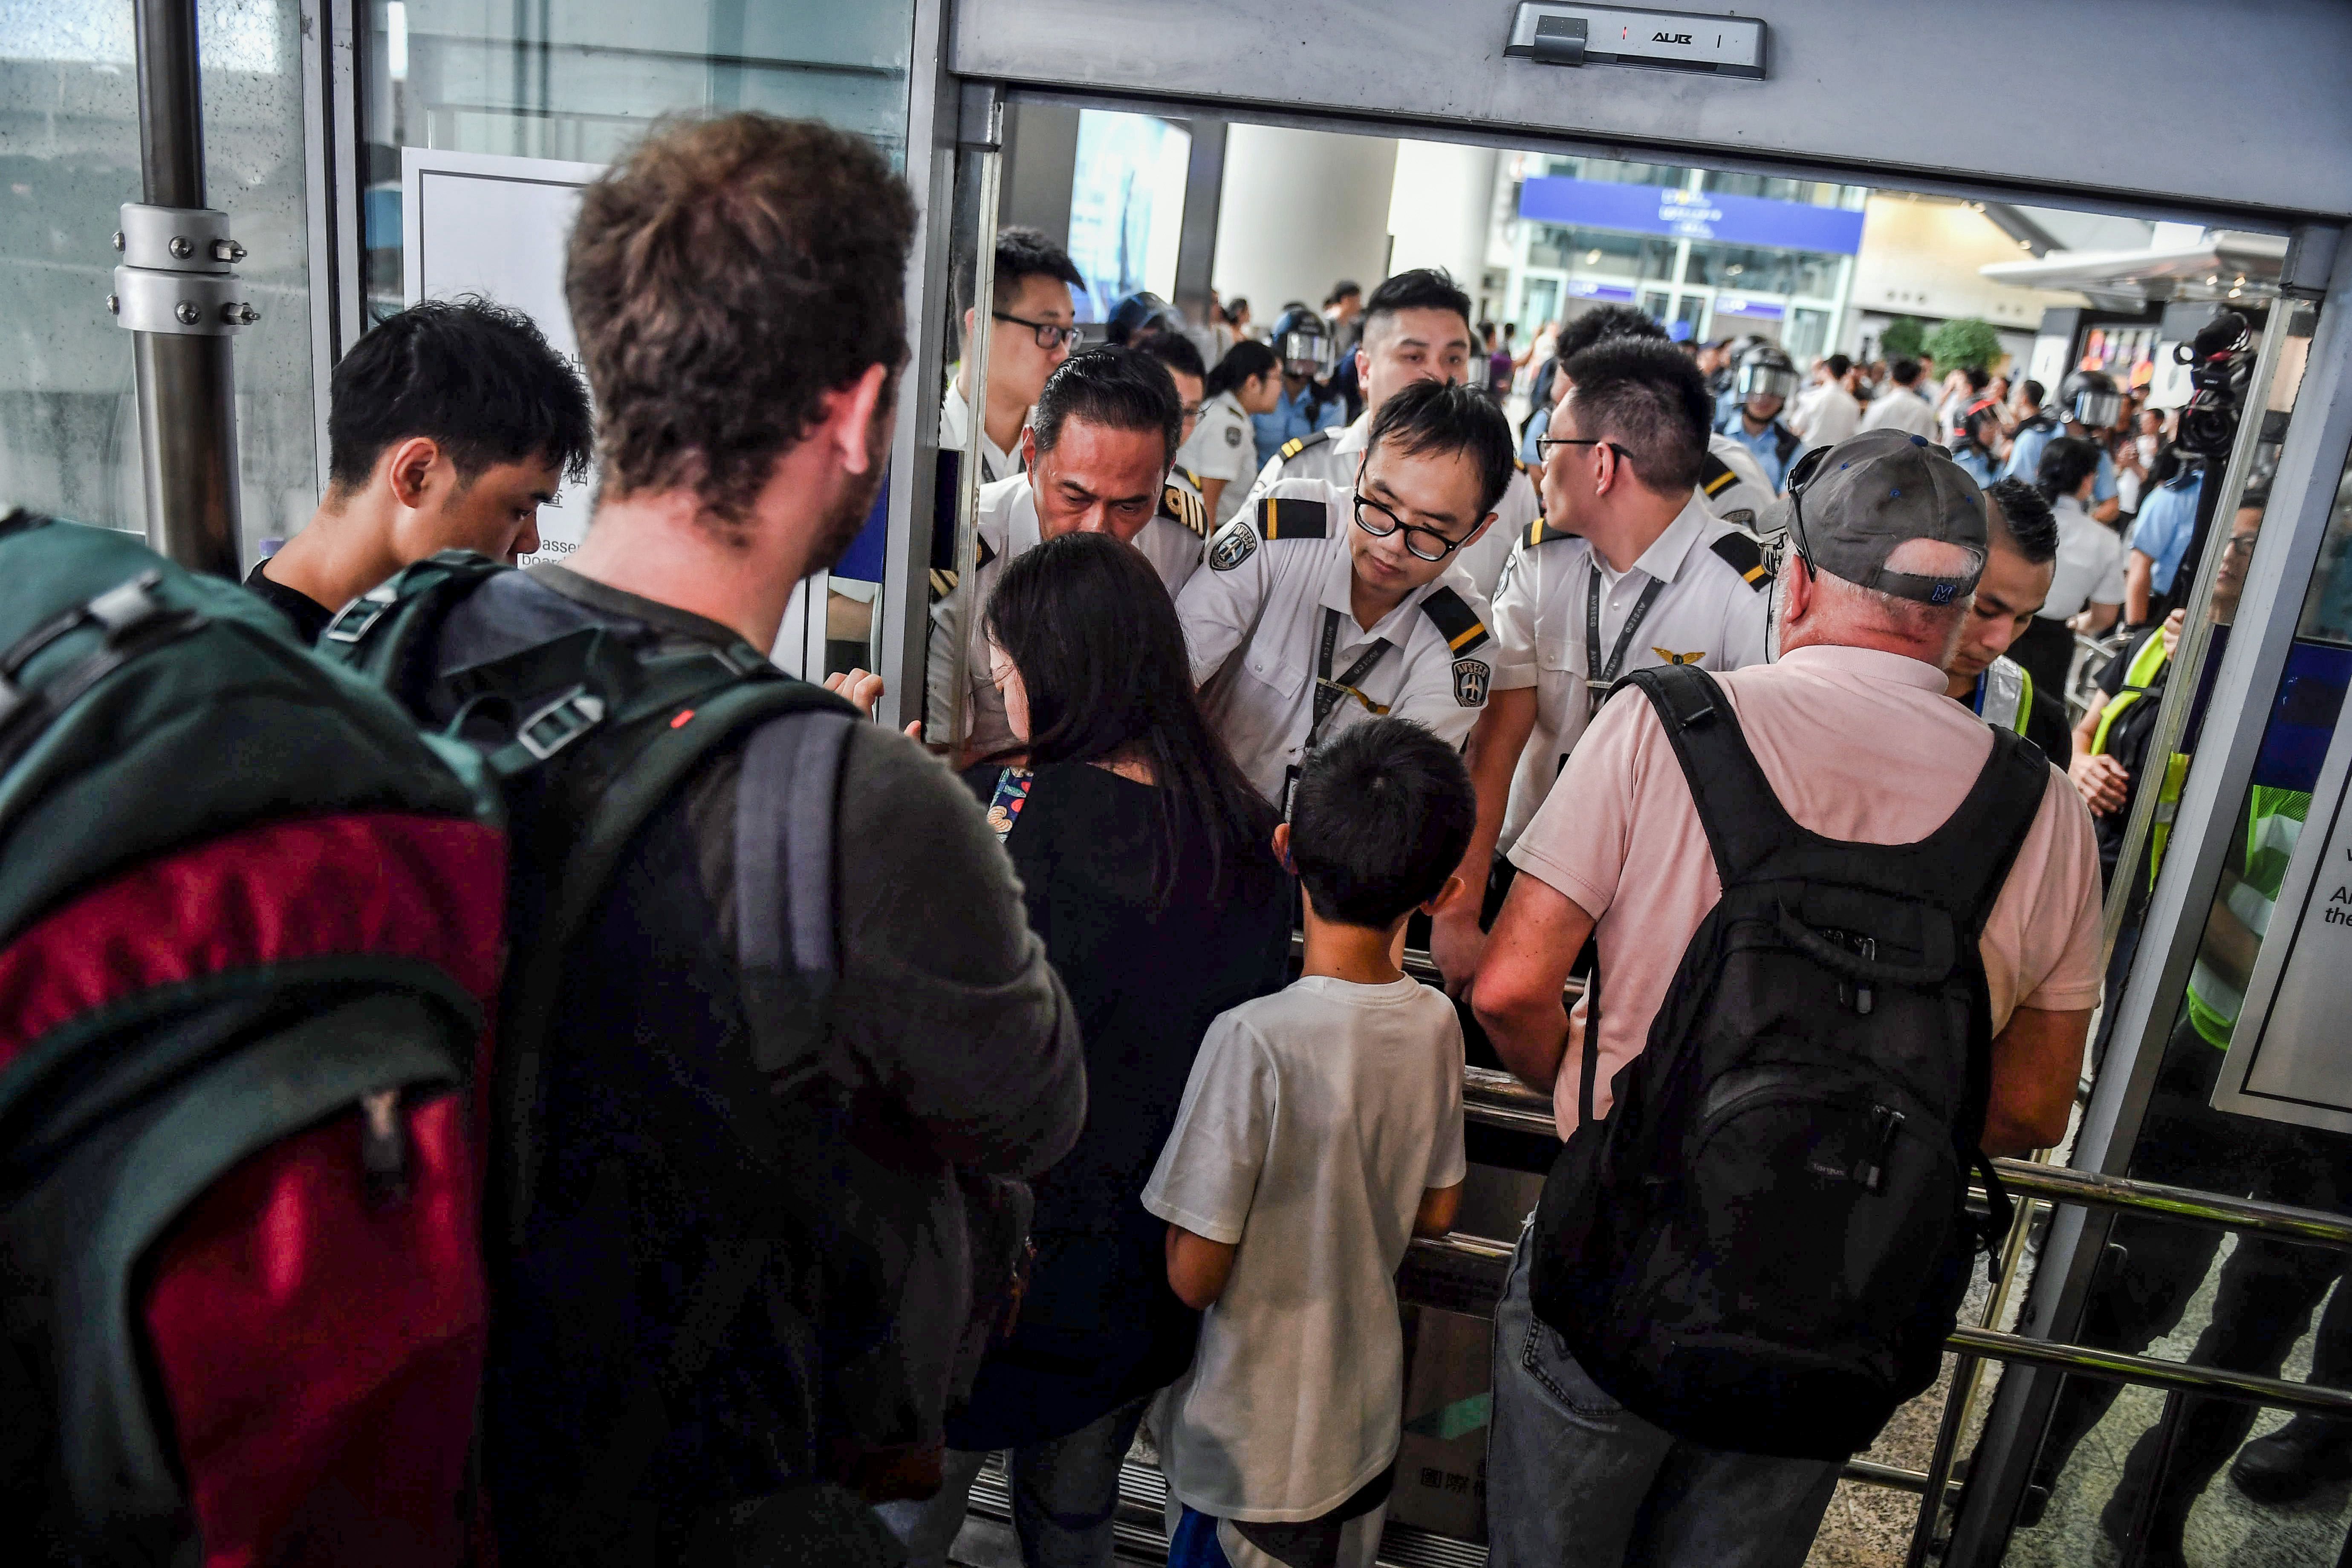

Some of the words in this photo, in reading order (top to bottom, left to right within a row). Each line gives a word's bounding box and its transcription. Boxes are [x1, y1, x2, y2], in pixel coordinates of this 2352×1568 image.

[1233, 525, 1254, 549] AVSECO
[541, 539, 580, 553] asse
[1932, 585, 1952, 602] M
[1456, 663, 1488, 677] AVSECO
